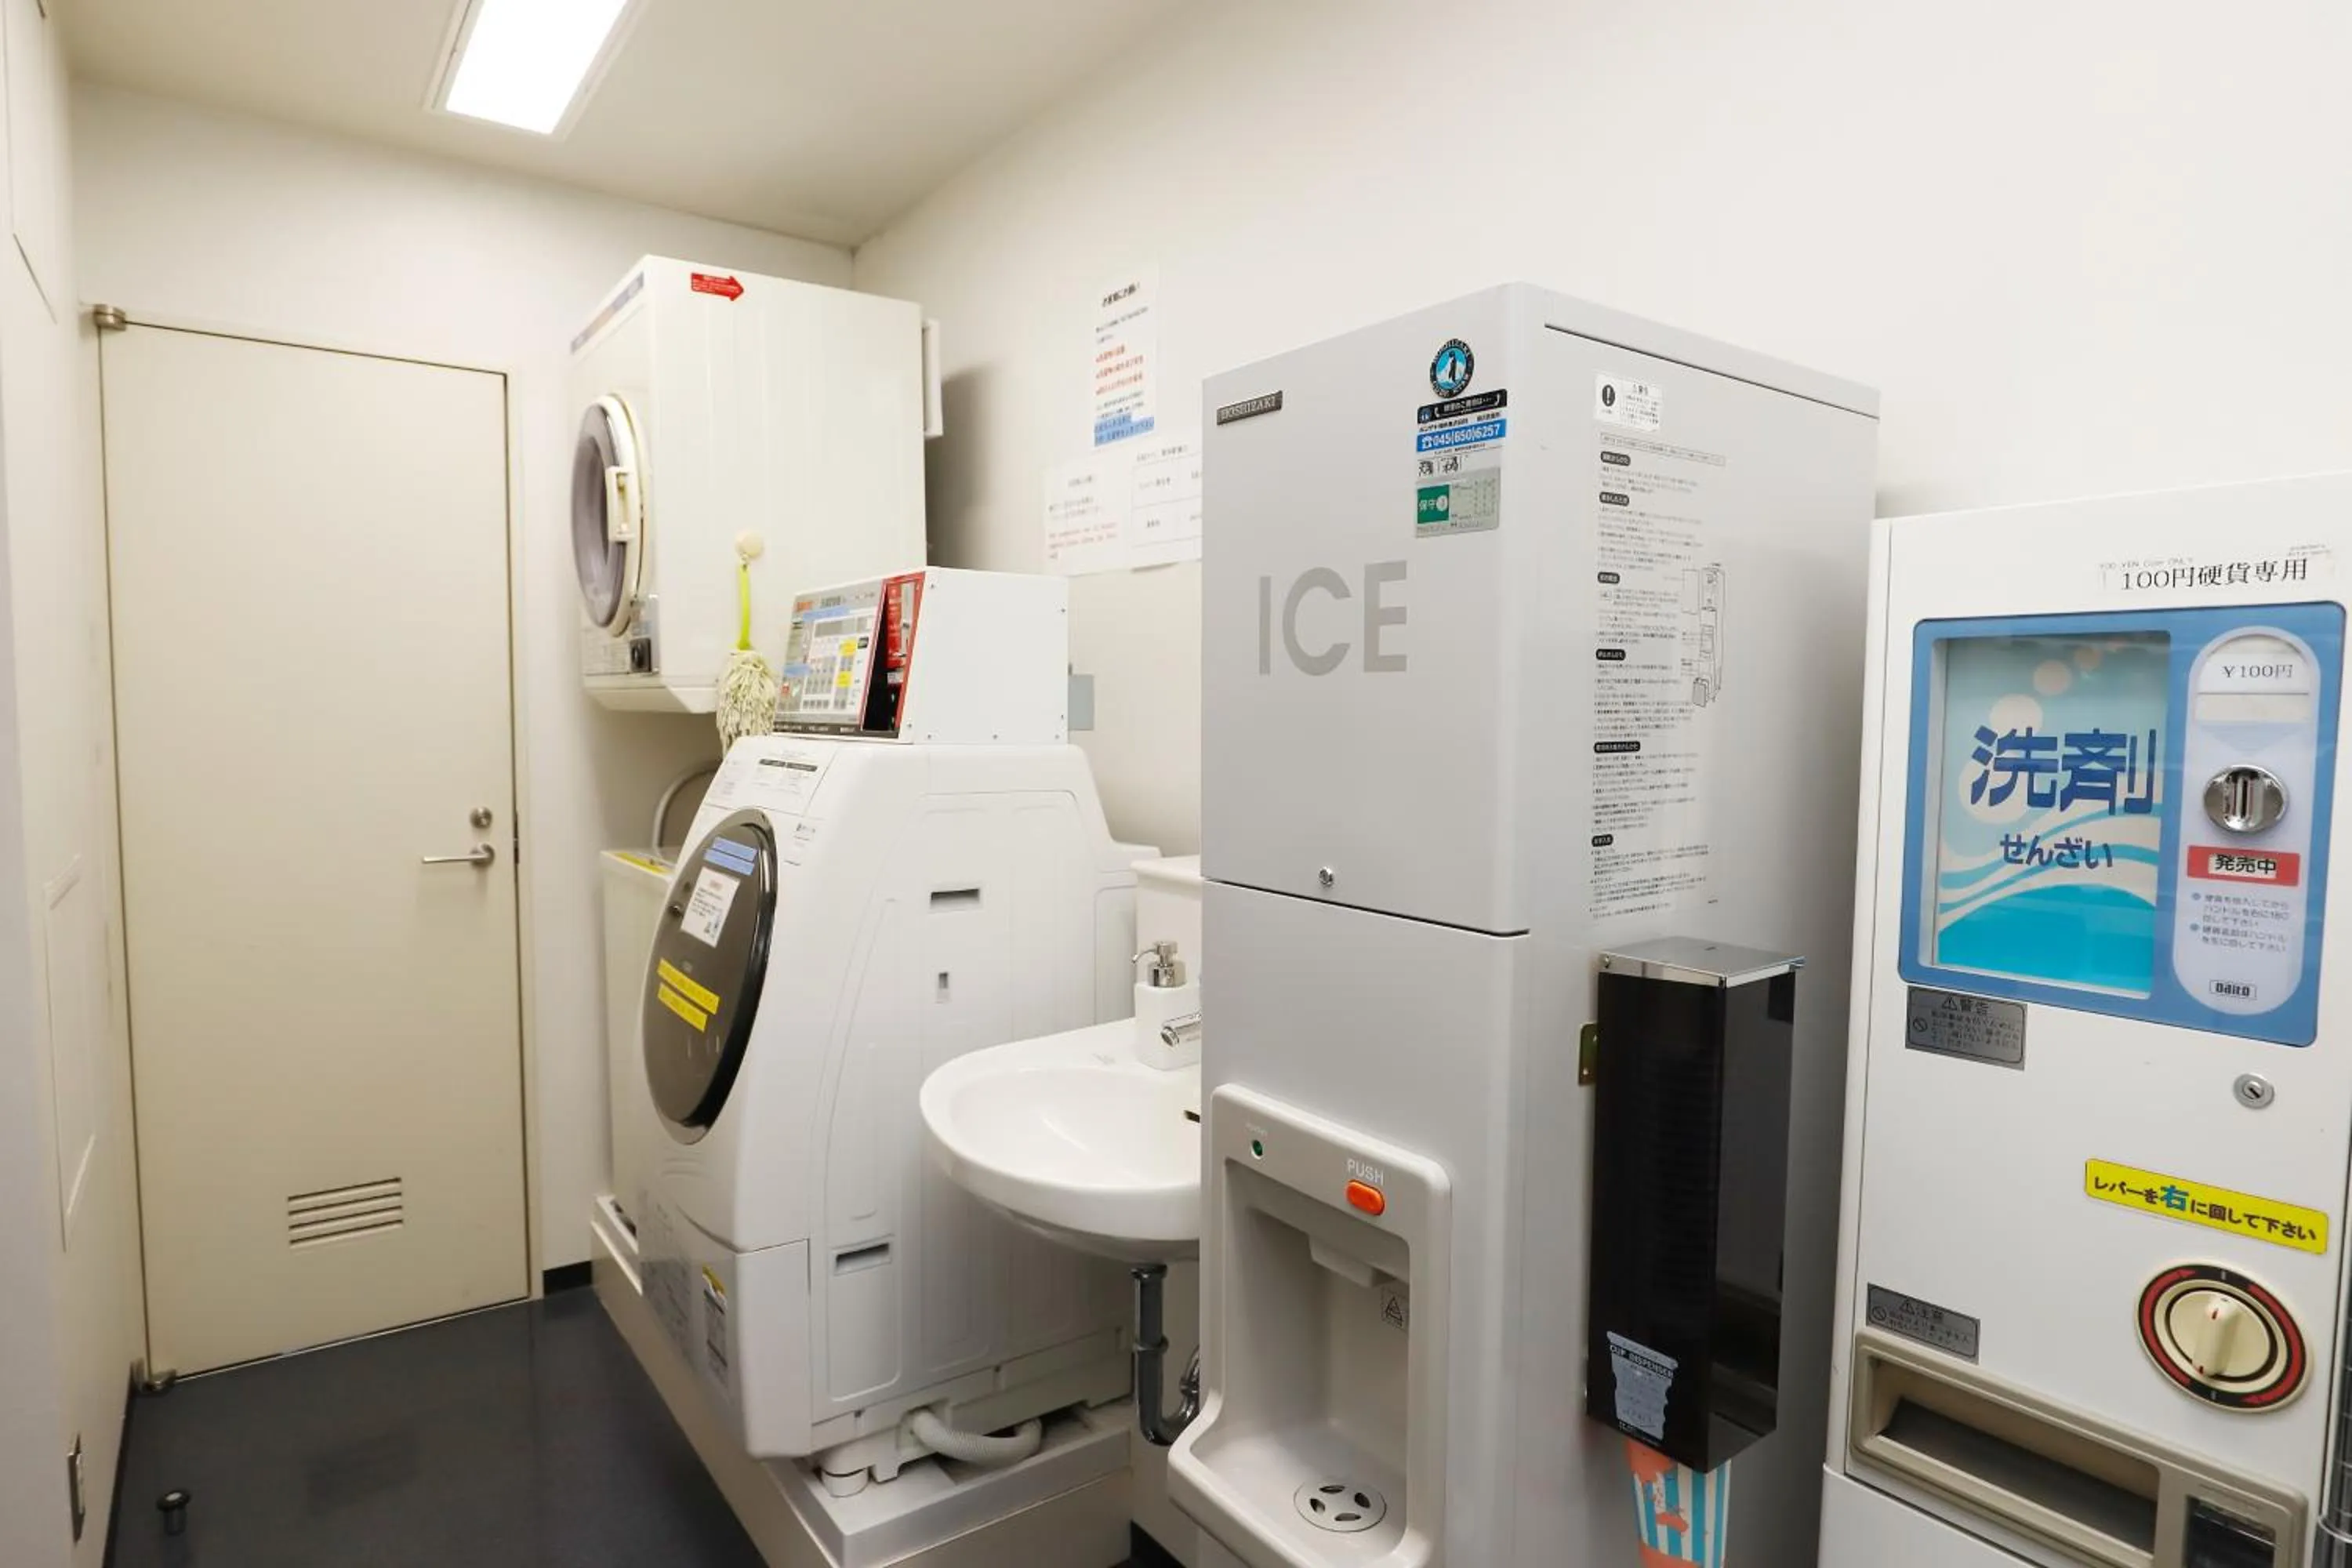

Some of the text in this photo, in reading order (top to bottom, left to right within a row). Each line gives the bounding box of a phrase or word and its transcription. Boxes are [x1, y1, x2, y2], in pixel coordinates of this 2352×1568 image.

[2120, 558, 2308, 590] 100円硬貨専用
[1259, 560, 1407, 677] ICE
[1970, 725, 2157, 815] 洗剤
[2000, 833, 2114, 869] せんざい
[2214, 853, 2276, 875] 発売中
[1347, 1159, 1384, 1185] PUSH
[2094, 1176, 2317, 1241] レバーを右に回して下さい
